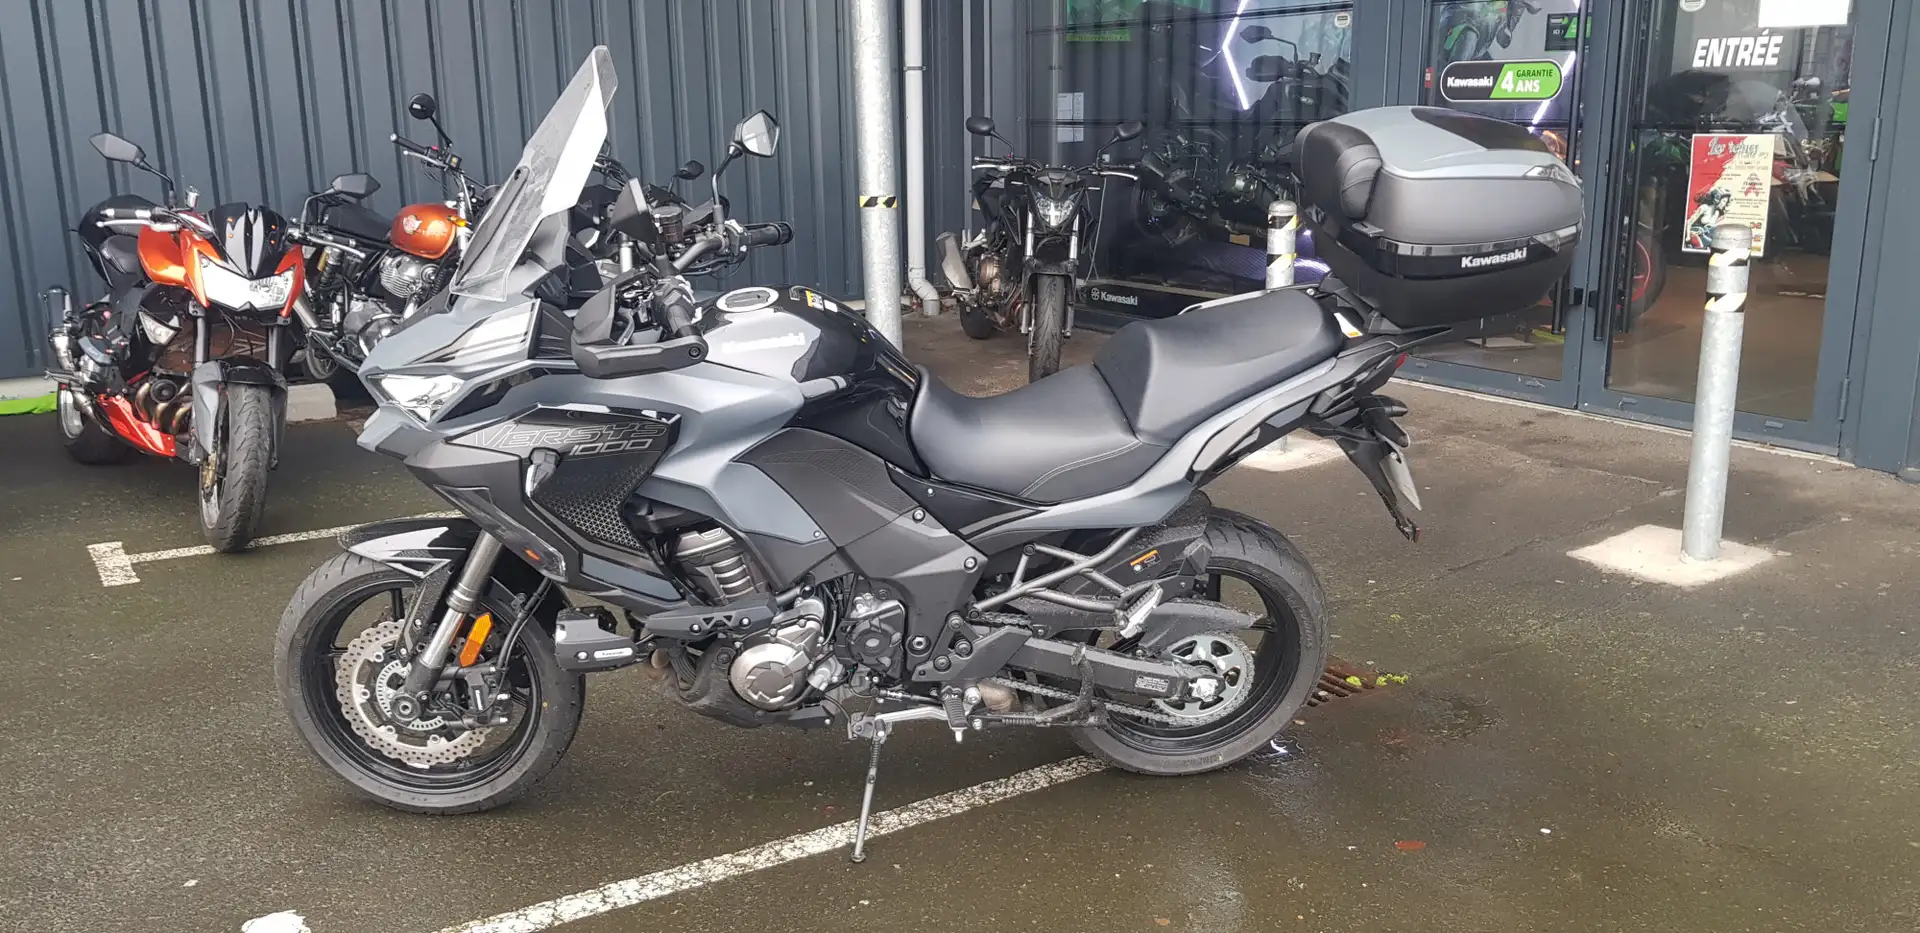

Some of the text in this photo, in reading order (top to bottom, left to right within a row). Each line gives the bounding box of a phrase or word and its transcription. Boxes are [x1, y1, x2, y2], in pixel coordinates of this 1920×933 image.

[1692, 28, 1784, 68] ENTRÉE
[1447, 76, 1494, 88] Kawasaki
[1501, 71, 1514, 93] 4
[1516, 69, 1553, 78] GARANTIE
[1515, 80, 1540, 93] ANS
[1461, 247, 1527, 268] Kawasaki
[1101, 291, 1138, 306] Kawasaki
[475, 422, 668, 449] VERSYS
[569, 438, 653, 457] 1000
